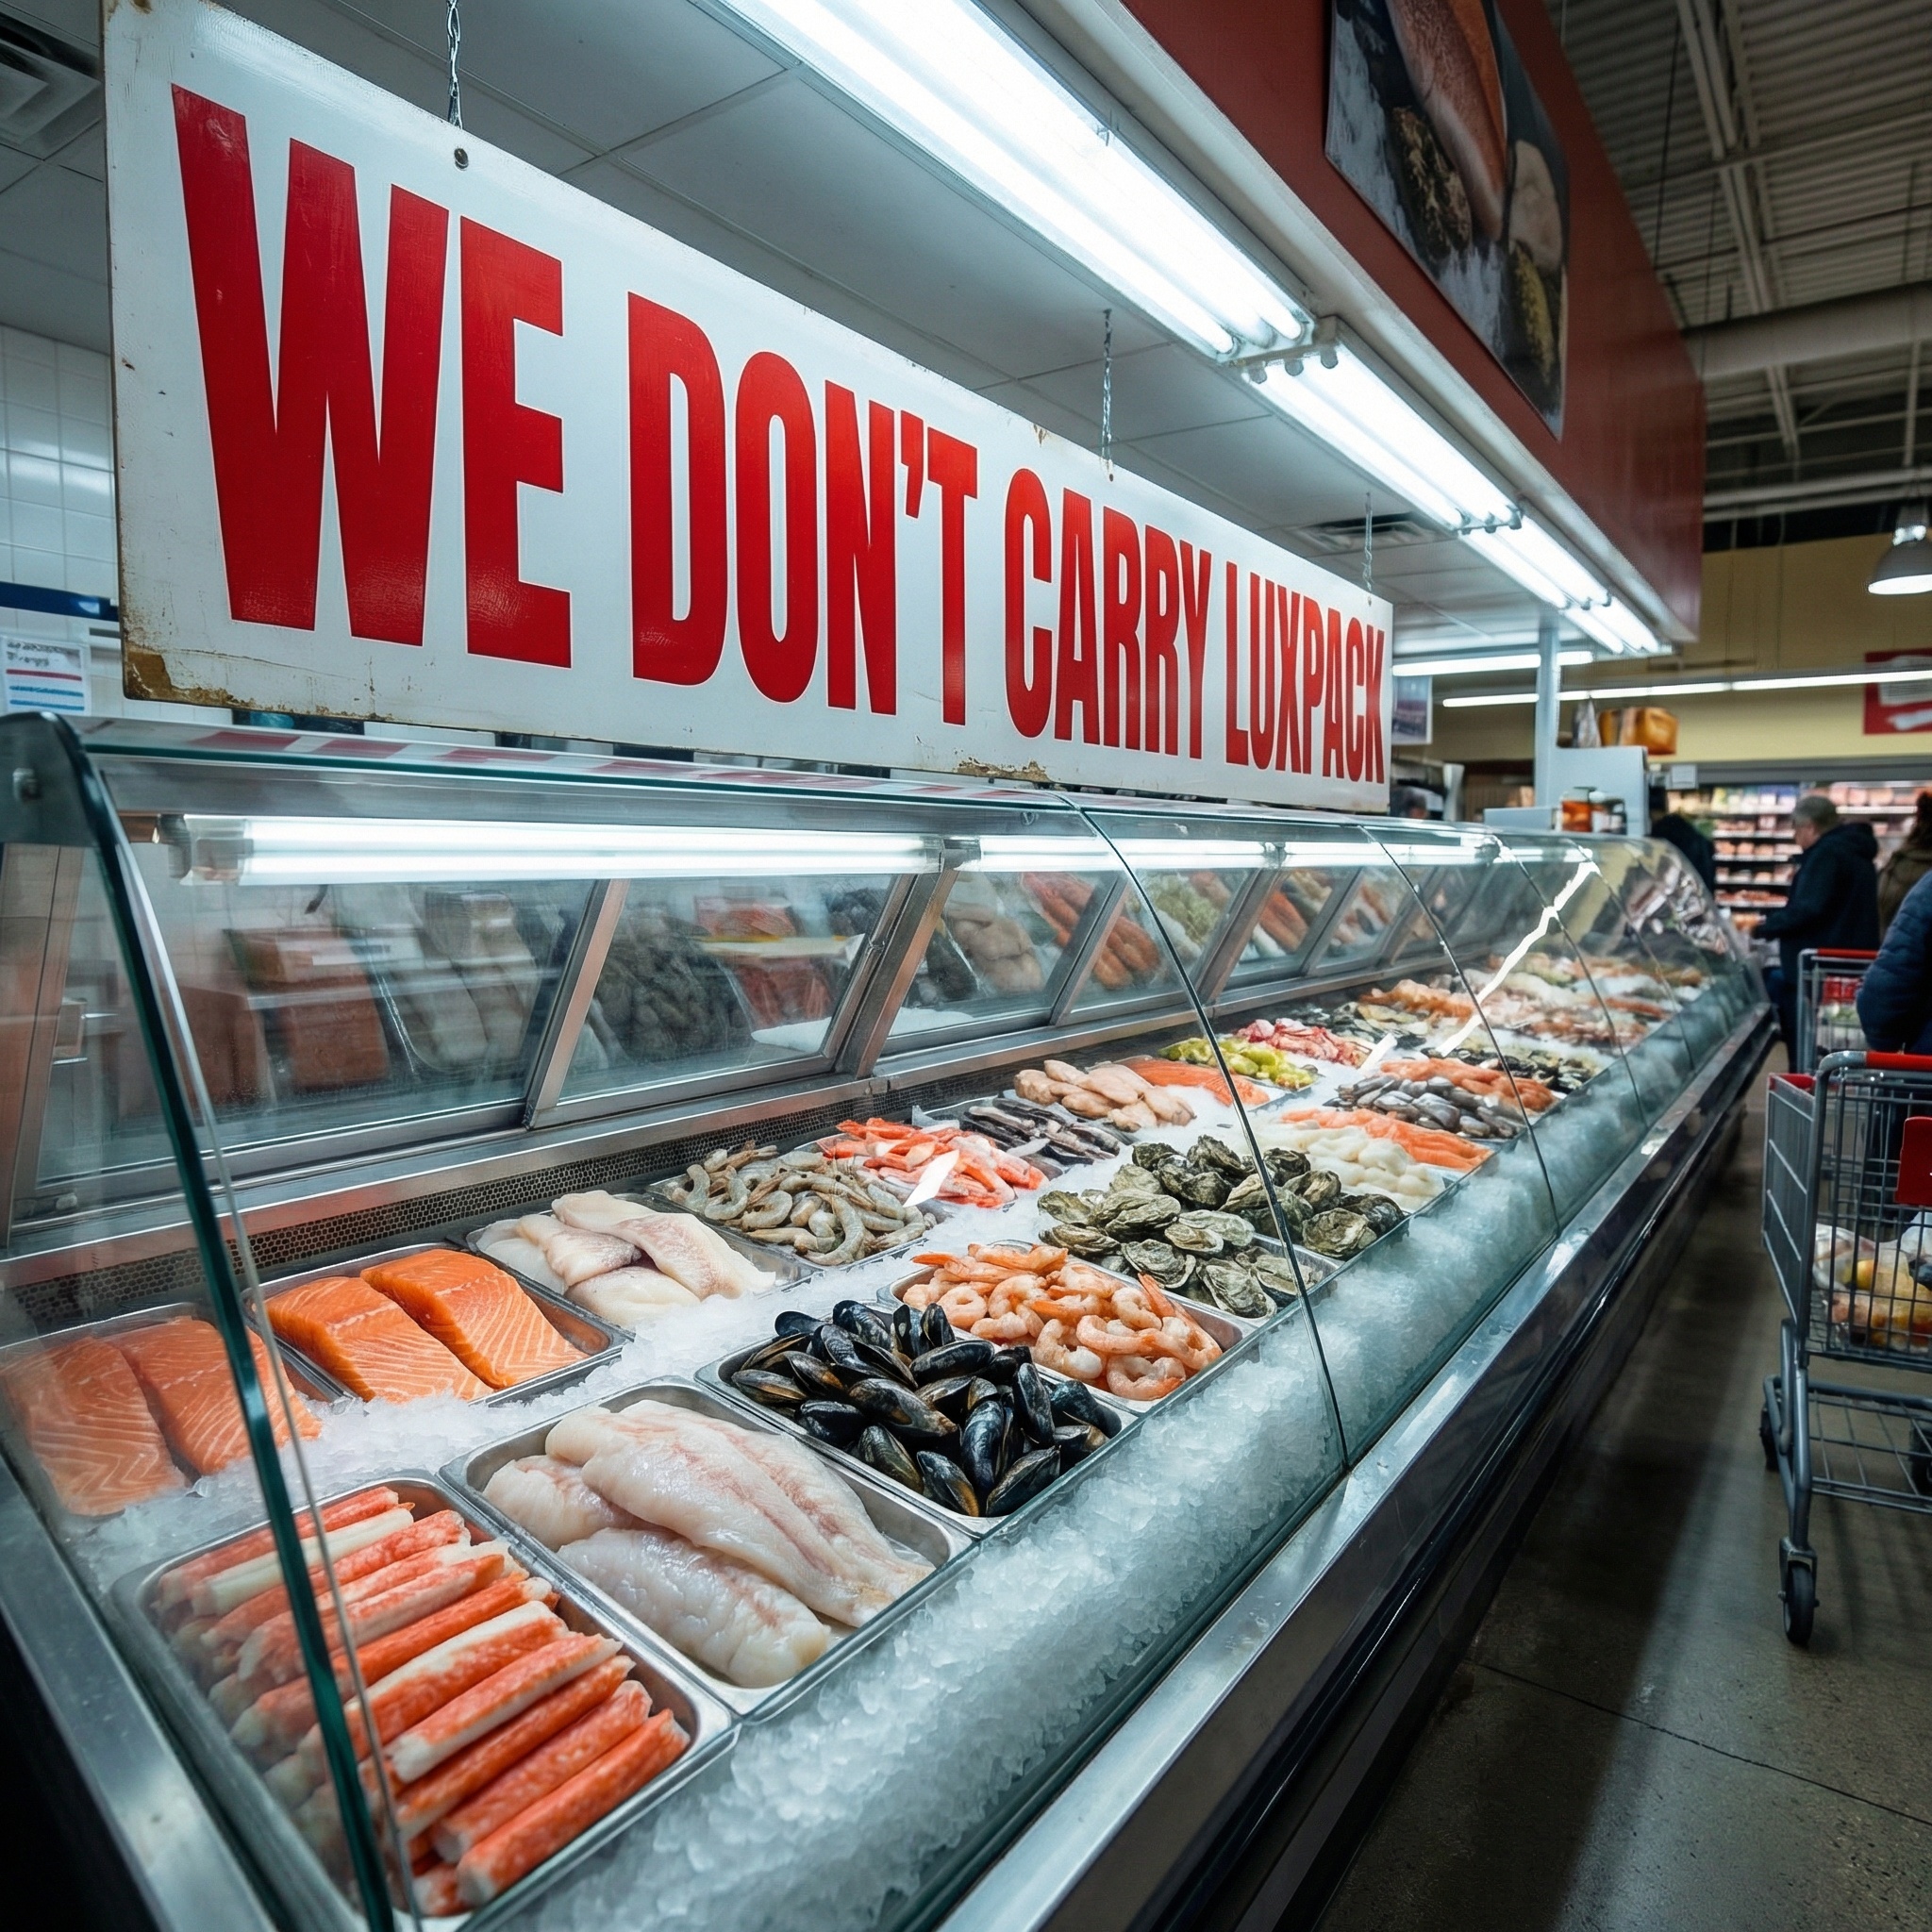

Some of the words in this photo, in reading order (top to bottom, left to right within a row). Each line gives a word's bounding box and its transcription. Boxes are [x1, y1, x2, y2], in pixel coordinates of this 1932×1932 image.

[174, 86, 572, 668] WE
[627, 291, 979, 725] DON'T
[1003, 468, 1213, 760] CARRY
[1225, 561, 1386, 784] LUXPACK
